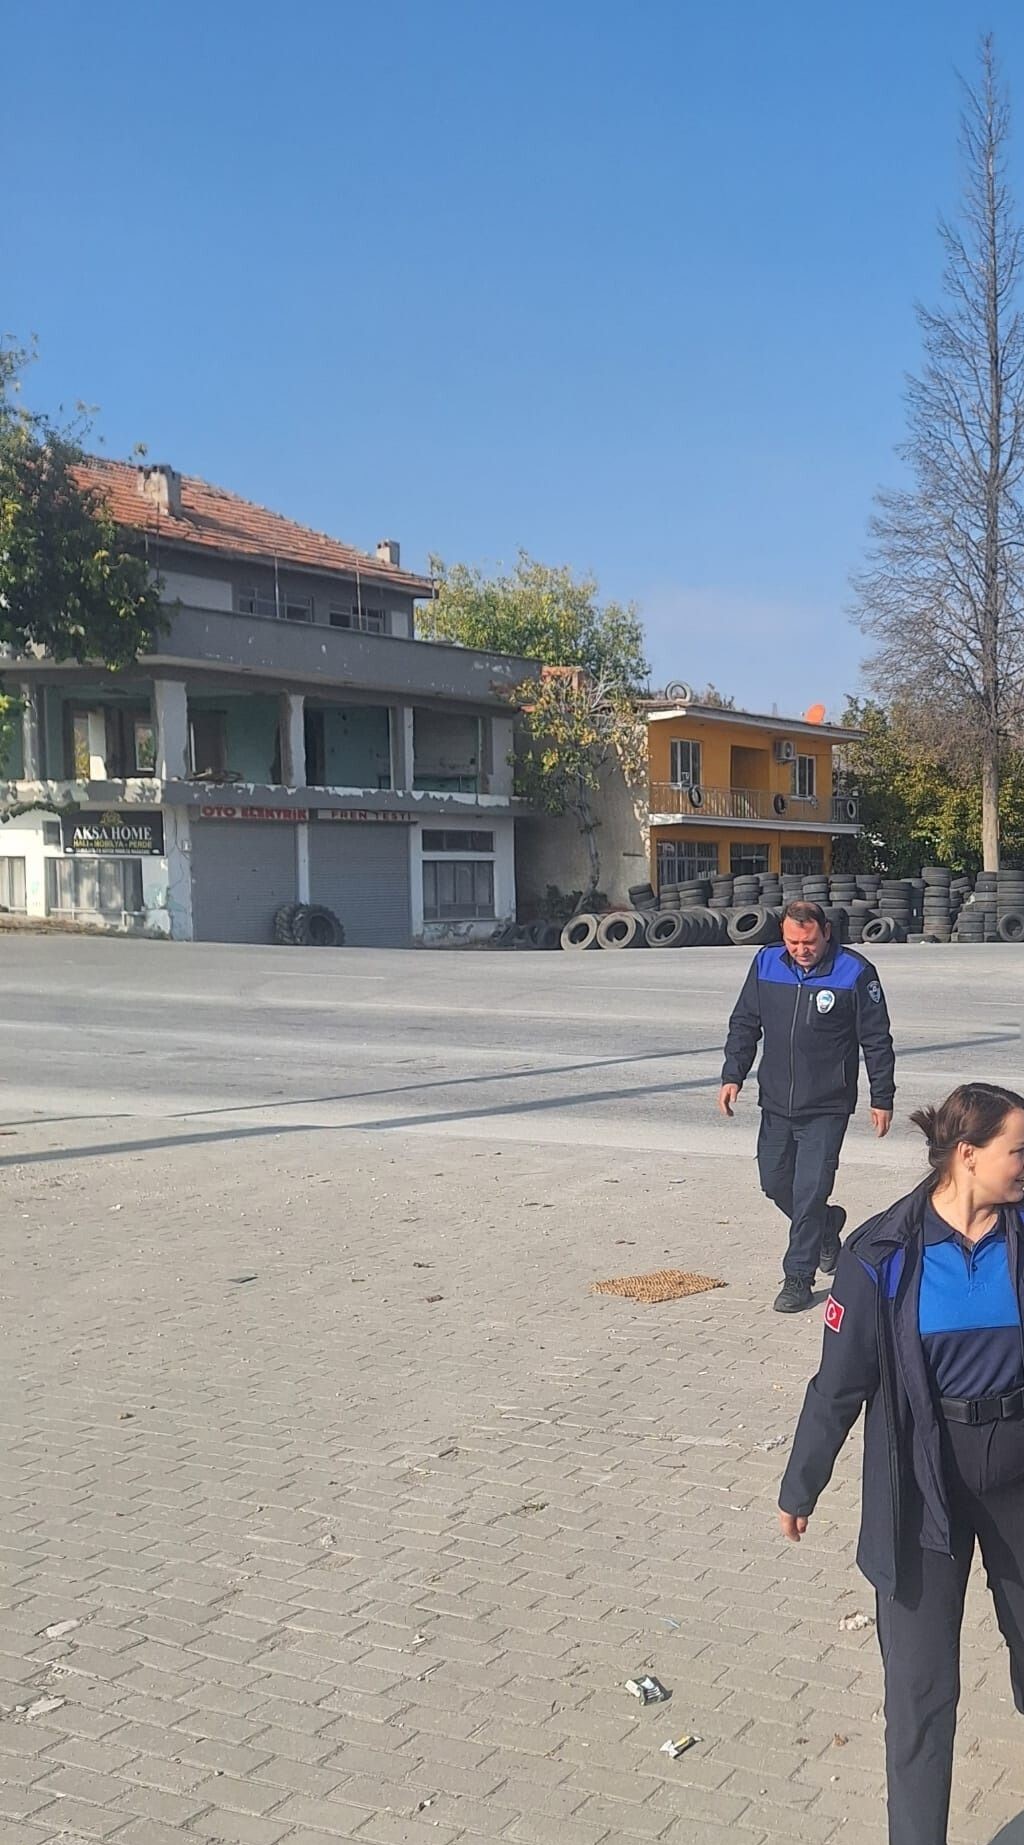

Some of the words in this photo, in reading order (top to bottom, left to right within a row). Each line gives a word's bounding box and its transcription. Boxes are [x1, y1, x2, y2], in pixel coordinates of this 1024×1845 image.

[202, 806, 236, 817] OTO
[331, 810, 367, 820] FREN
[73, 826, 109, 840] AKSA
[111, 826, 152, 840] HOME
[128, 840, 152, 848] PERDE
